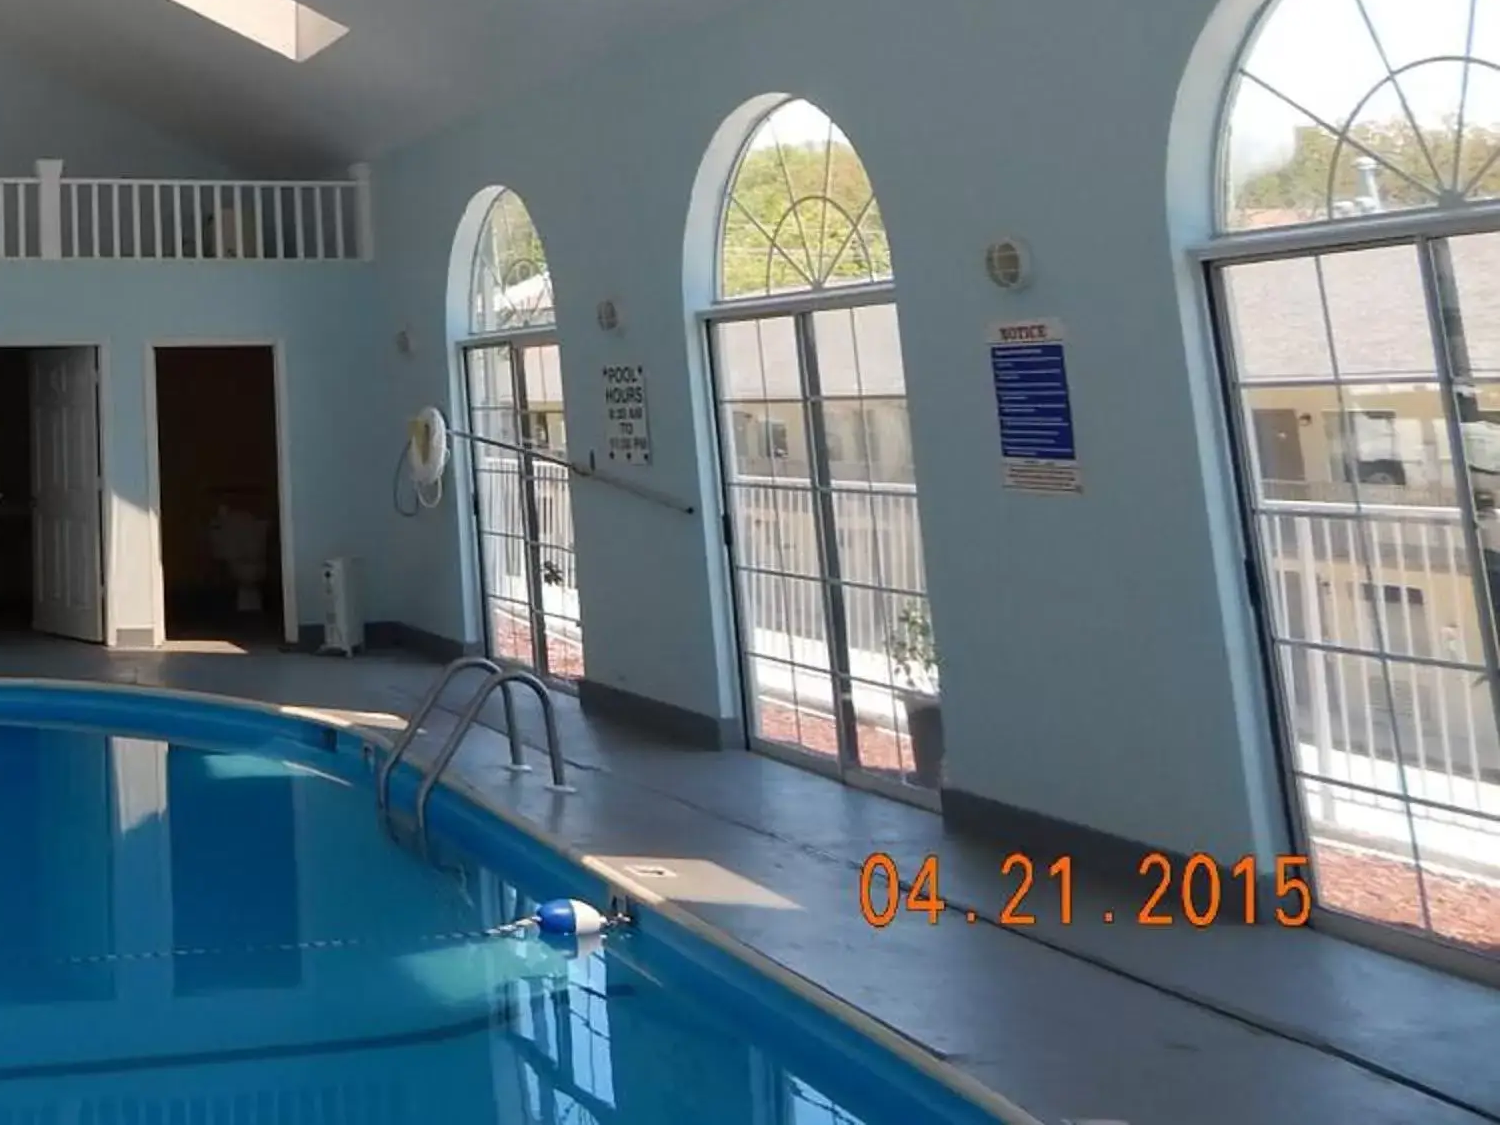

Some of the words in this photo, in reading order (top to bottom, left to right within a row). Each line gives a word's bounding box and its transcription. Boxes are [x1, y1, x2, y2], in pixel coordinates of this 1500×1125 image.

[998, 324, 1048, 340] NOTICE
[608, 366, 638, 383] POOL
[605, 386, 643, 404] HOURS
[619, 422, 633, 435] TO
